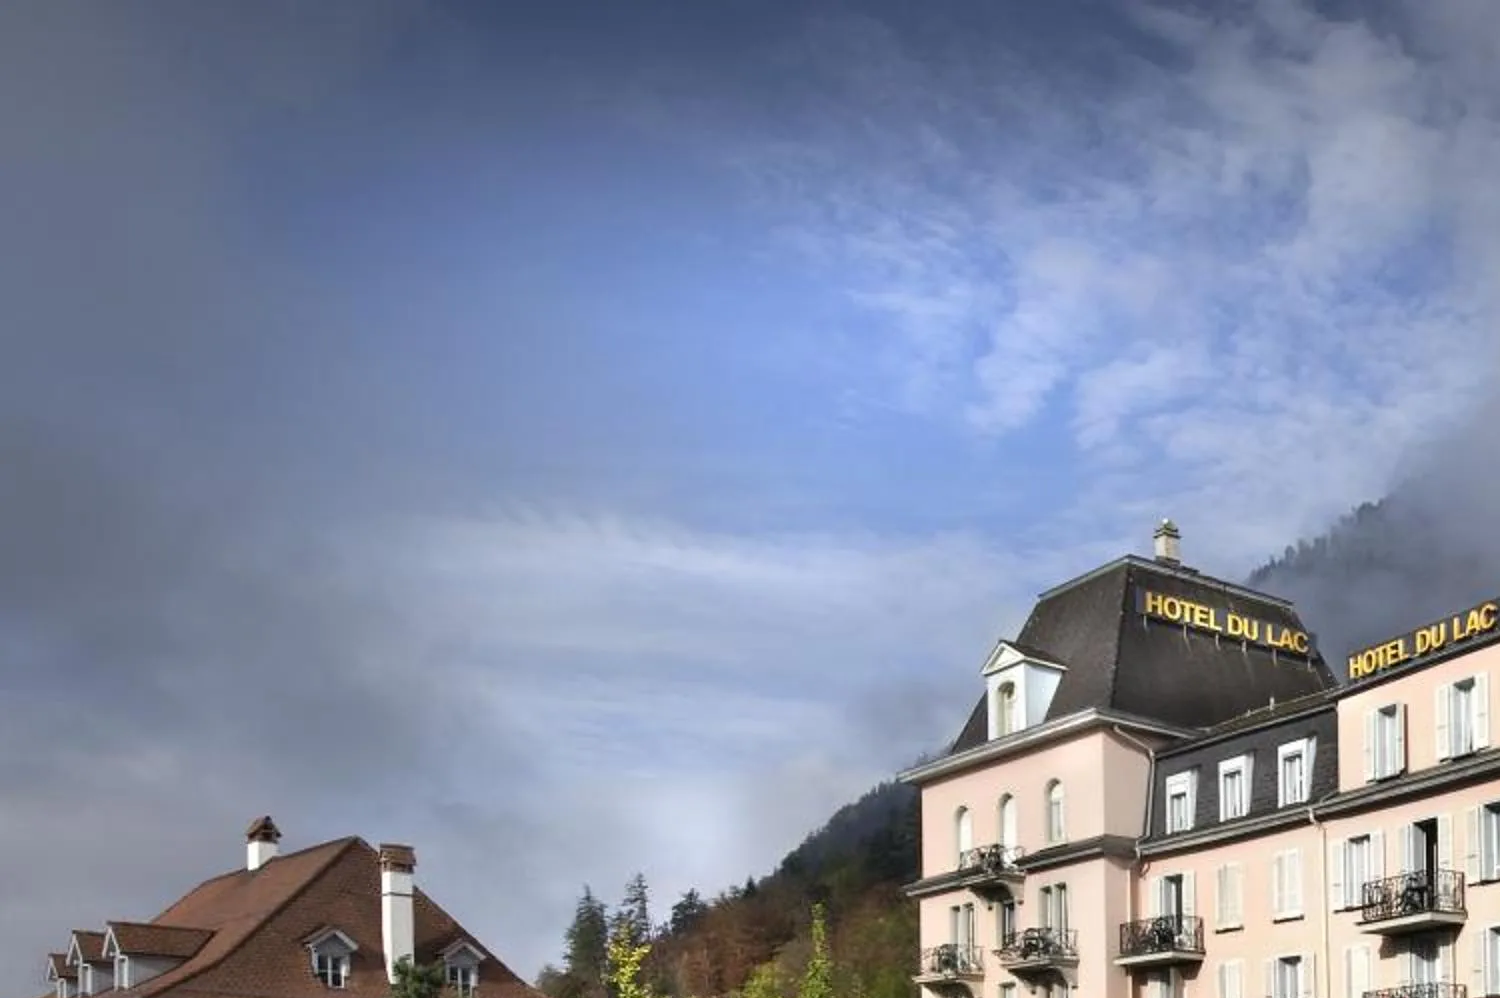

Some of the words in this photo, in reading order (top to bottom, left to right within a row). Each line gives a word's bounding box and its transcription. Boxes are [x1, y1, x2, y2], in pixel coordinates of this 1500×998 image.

[1146, 591, 1222, 631] HOTEL
[1227, 612, 1259, 641] DU
[1266, 624, 1310, 654] LAC
[1348, 639, 1410, 679] HOTEL
[1414, 622, 1446, 652] DU
[1453, 603, 1498, 641] LAC
